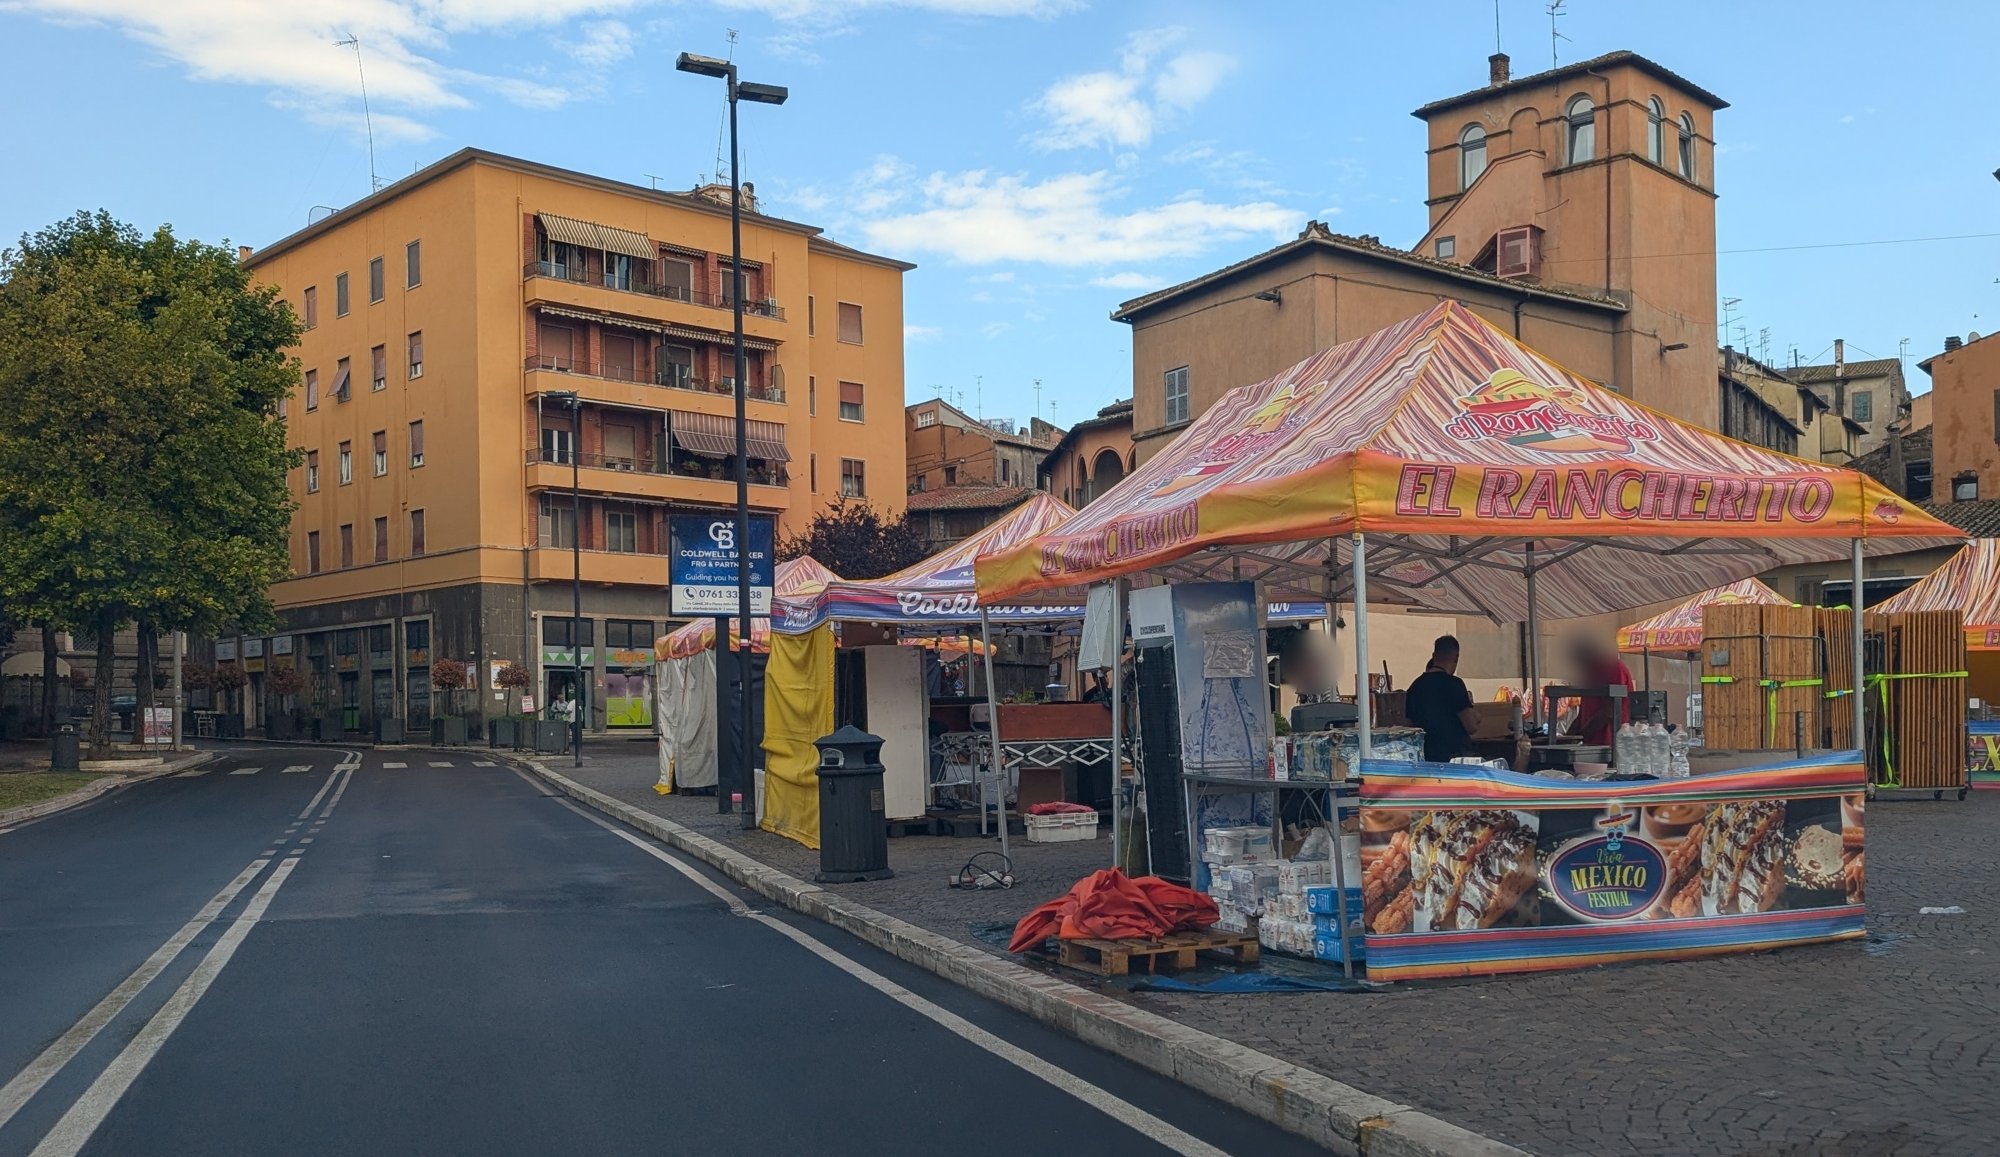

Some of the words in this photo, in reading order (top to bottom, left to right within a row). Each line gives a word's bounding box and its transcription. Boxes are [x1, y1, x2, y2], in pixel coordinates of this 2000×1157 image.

[1447, 420, 1471, 440] el
[1472, 404, 1658, 442] Rancherito
[1396, 464, 1461, 517] EL
[1475, 467, 1834, 522] RANCHERITO
[680, 549, 727, 558] COLDWELL
[715, 561, 754, 569] PARTNS
[685, 573, 712, 582] Guiding
[713, 574, 727, 582] you
[699, 589, 723, 599] 0761
[726, 590, 762, 599] 3338
[1570, 864, 1647, 892] MEXICO
[1587, 891, 1633, 908] FESTIVAL
